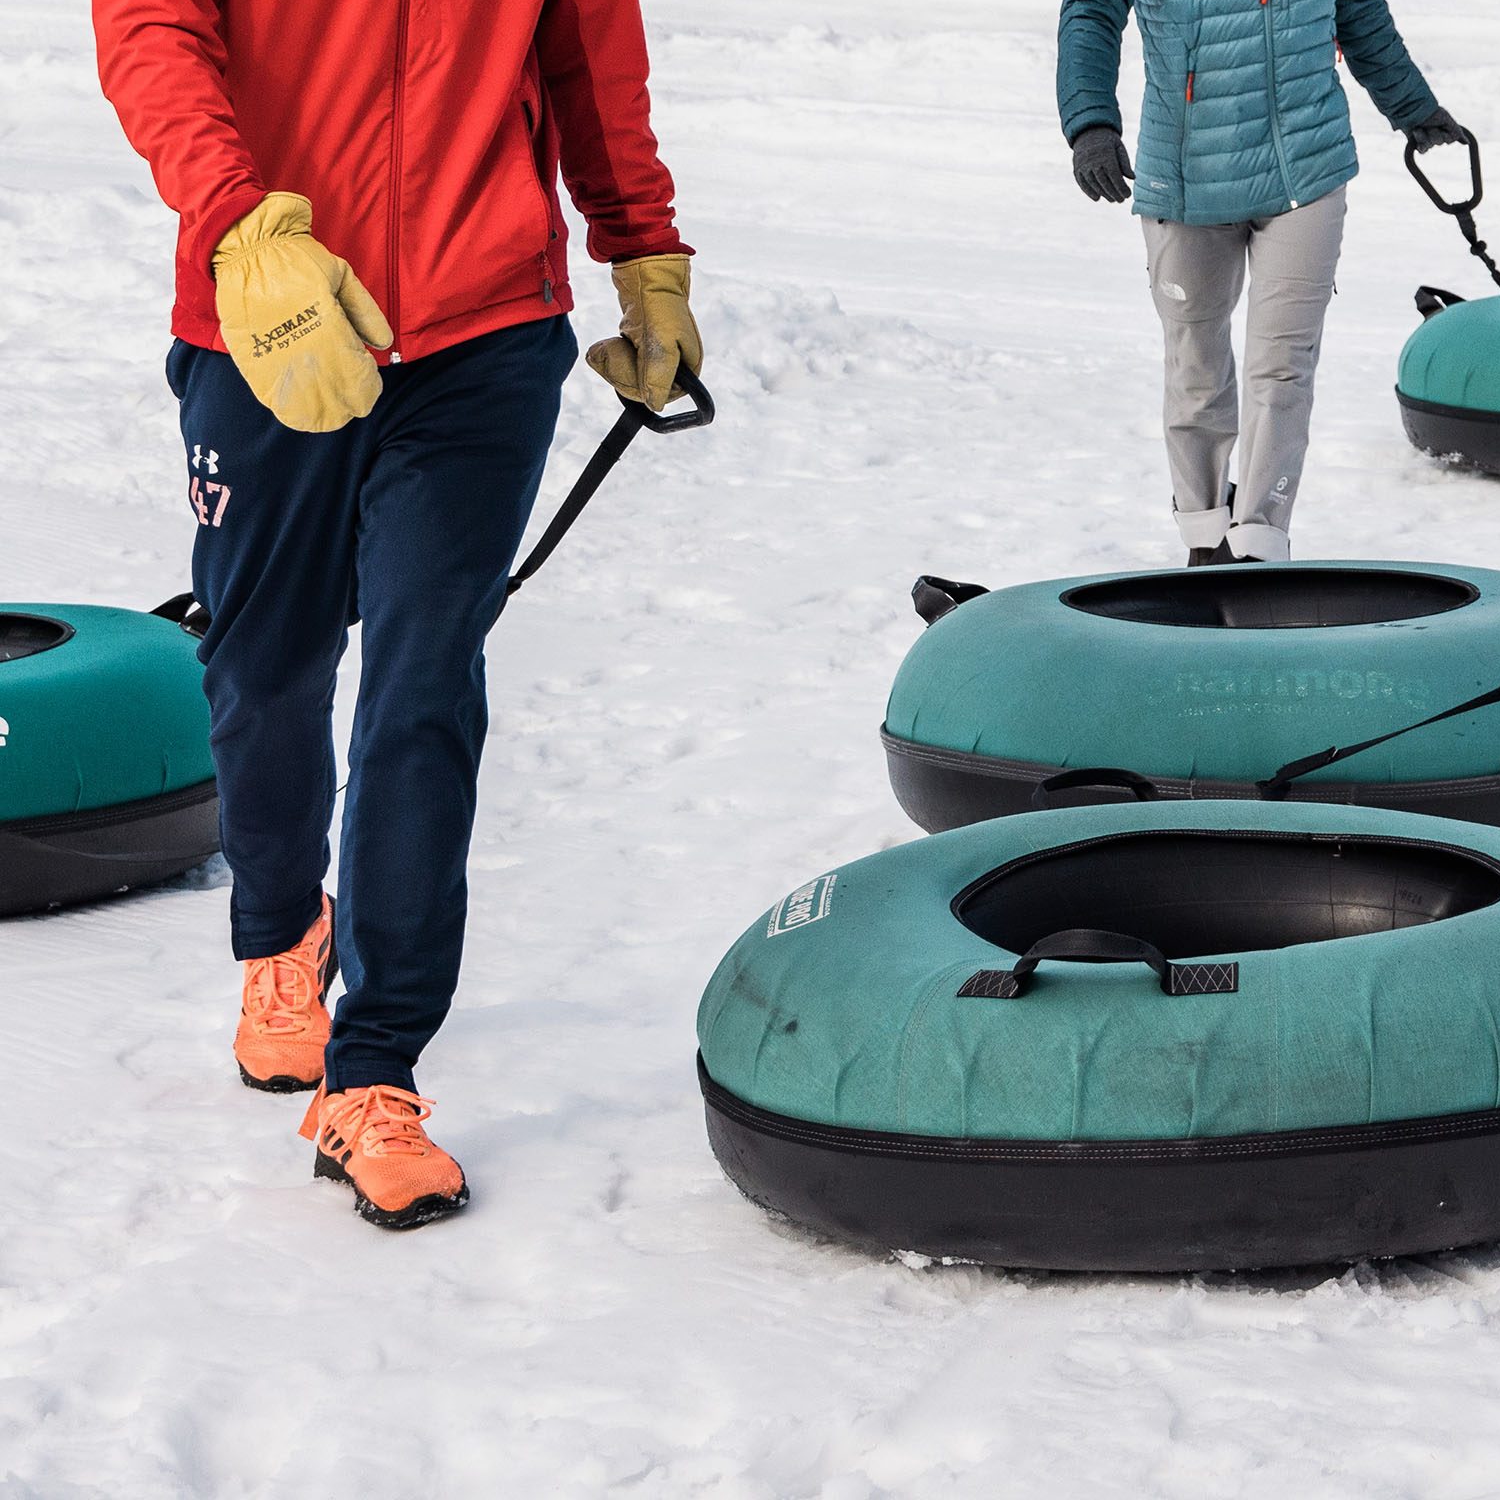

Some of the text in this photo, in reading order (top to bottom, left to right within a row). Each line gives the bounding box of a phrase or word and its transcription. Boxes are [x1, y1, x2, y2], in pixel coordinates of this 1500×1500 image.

[277, 320, 322, 349] by Kinco
[190, 476, 231, 527] 47
[784, 901, 812, 925] PRO
